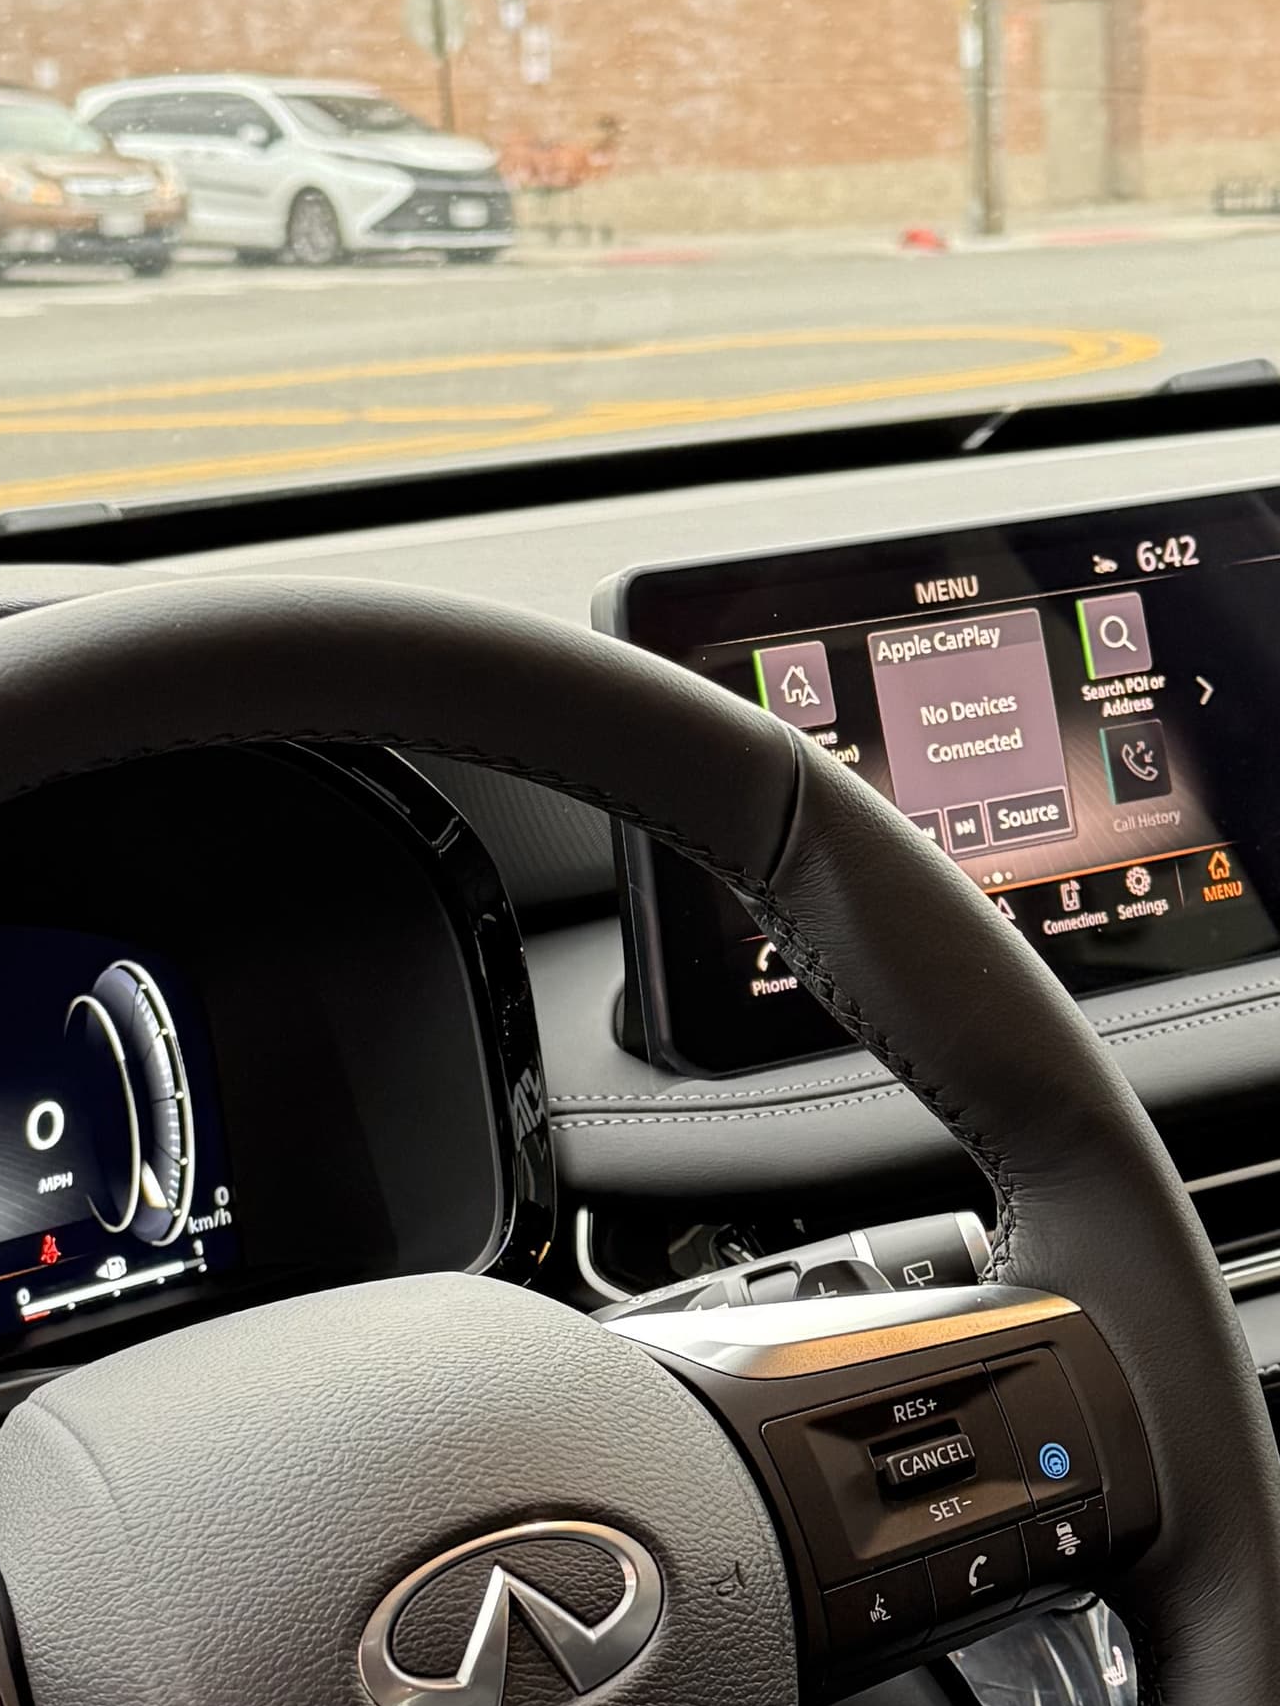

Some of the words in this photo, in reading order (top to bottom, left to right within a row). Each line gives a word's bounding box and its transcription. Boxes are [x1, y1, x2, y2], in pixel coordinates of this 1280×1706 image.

[1136, 535, 1200, 572] 6:42
[915, 575, 979, 605] MENU
[877, 633, 932, 663] Apple
[934, 624, 1000, 654] CarPlay
[1082, 680, 1124, 702] Search
[1126, 677, 1147, 695] POI
[1148, 675, 1166, 691] or
[920, 704, 948, 726] No
[951, 694, 1018, 722] Devices
[1102, 695, 1154, 718] Address
[927, 729, 1023, 764] Connected
[997, 801, 1059, 830] Source
[1113, 815, 1137, 834] Call
[1139, 807, 1181, 830] History
[1203, 881, 1243, 903] MENU
[1043, 910, 1108, 935] Connections
[1117, 897, 1169, 921] Settings
[751, 975, 797, 997] Phone
[26, 1100, 65, 1151] 0
[38, 1171, 73, 1194] MPH
[214, 1186, 229, 1206] 0
[188, 1208, 232, 1234] km/h
[893, 1397, 938, 1424] RES+
[899, 1442, 970, 1478] CANCEL
